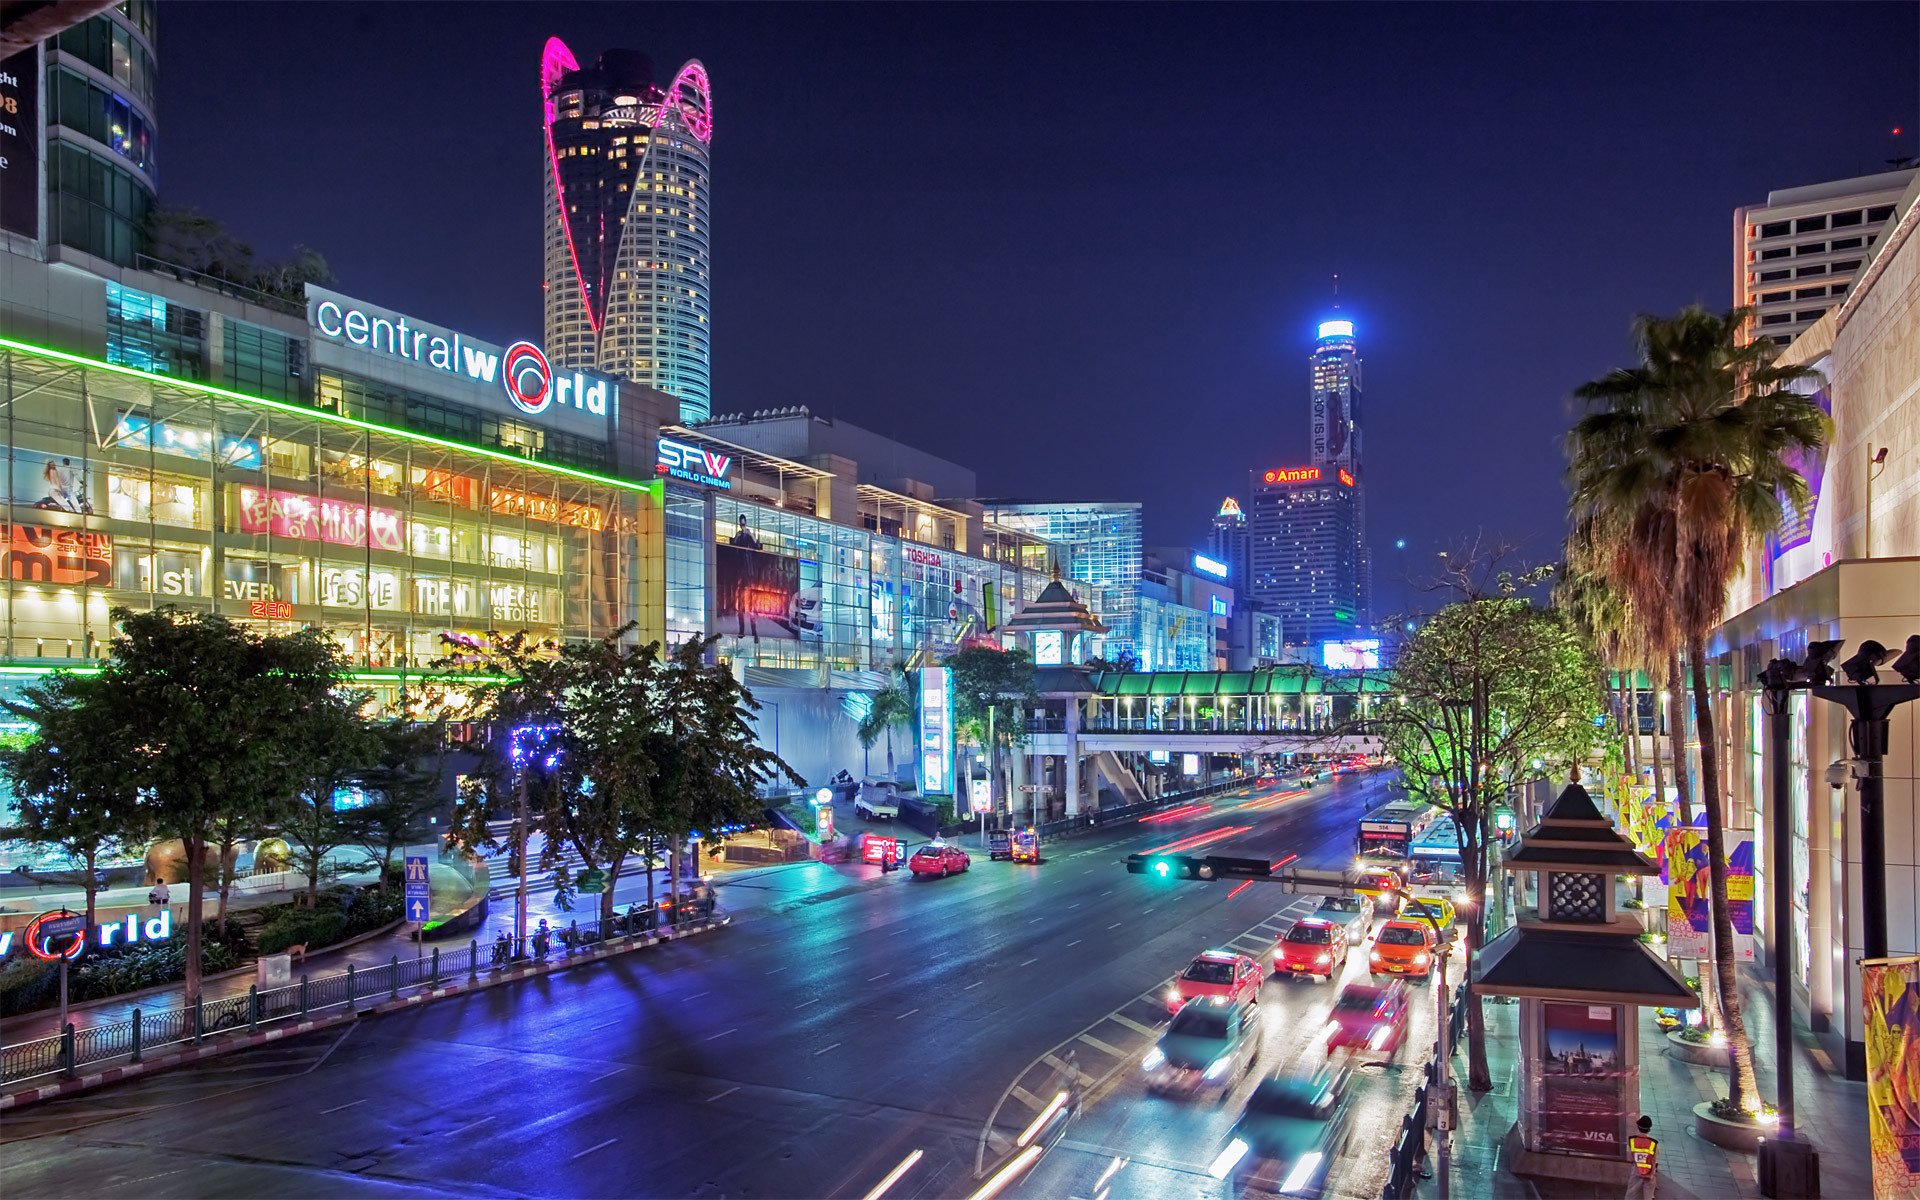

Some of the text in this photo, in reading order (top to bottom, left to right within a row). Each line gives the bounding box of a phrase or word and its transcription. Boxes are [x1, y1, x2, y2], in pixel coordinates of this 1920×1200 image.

[669, 467, 700, 481] WORLD
[700, 475, 731, 489] CINEMA
[1277, 468, 1319, 482] Amari
[906, 547, 941, 566] TOSHIBA
[139, 553, 194, 597] 1st
[416, 579, 471, 616] TREND
[490, 585, 539, 608] MEGA
[251, 602, 292, 619] ZEN
[494, 605, 539, 622] STORE
[1440, 1121, 1447, 1129] 3
[1583, 1131, 1616, 1143] VISA
